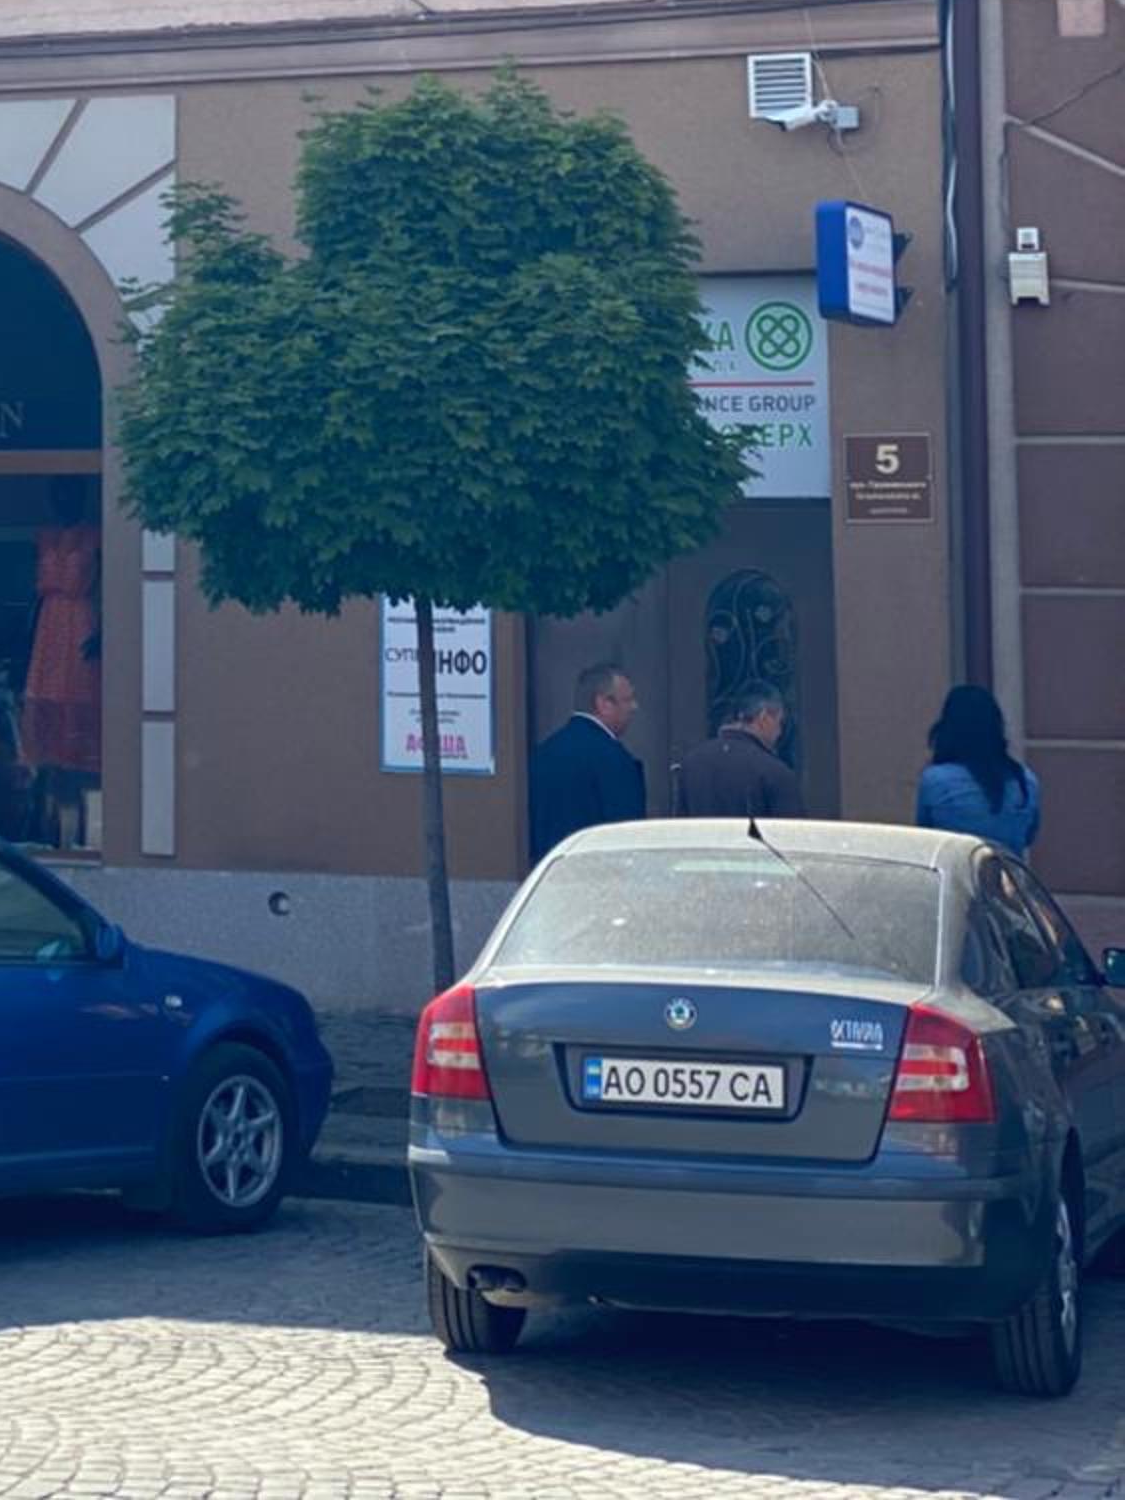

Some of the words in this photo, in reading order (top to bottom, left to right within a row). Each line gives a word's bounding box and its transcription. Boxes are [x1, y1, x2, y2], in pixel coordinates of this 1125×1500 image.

[749, 394, 815, 412] GROUP
[875, 444, 900, 475] 5
[604, 1066, 646, 1096] AO
[654, 1068, 722, 1100] 0557
[729, 1072, 773, 1103] CA
